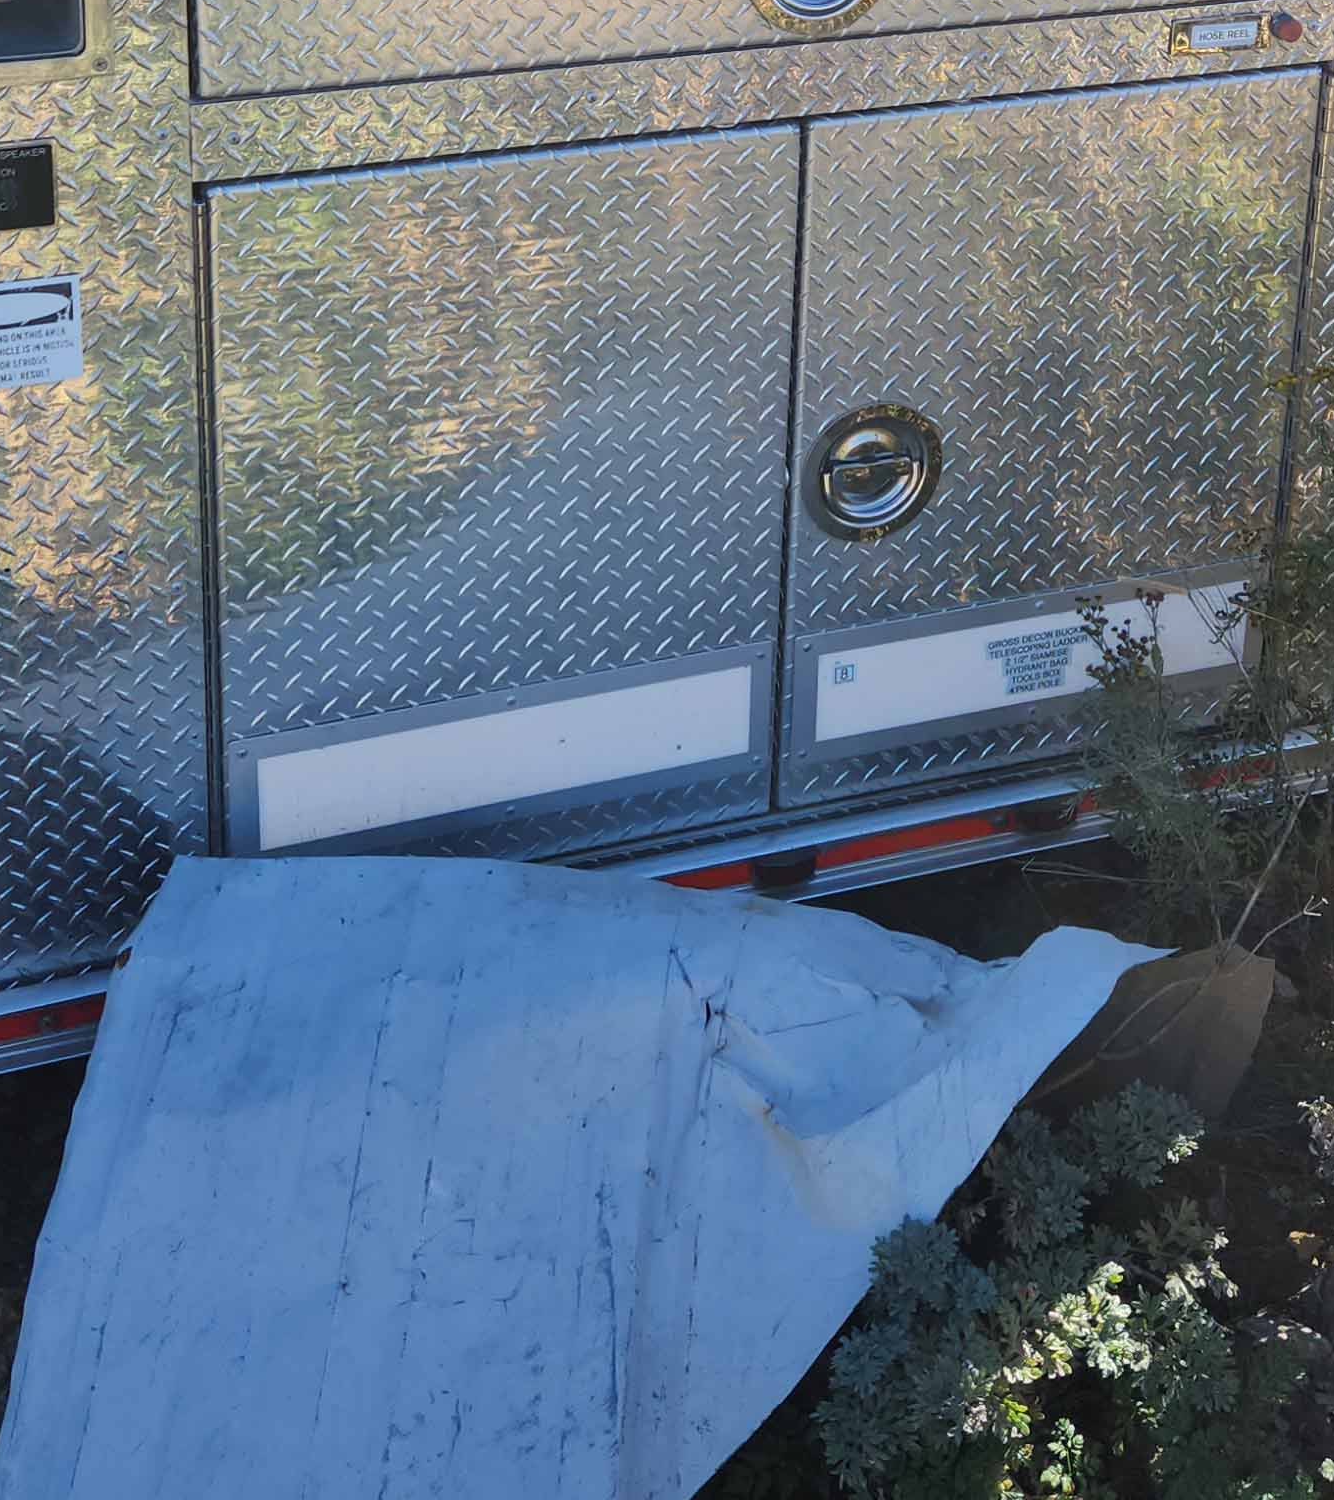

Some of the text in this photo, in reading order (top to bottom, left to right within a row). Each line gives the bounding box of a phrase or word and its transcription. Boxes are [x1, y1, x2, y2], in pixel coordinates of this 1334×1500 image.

[1199, 29, 1251, 41] HOSE REEL
[0, 148, 46, 159] SPEAKER
[11, 332, 22, 342] ON
[25, 330, 43, 339] THIS
[0, 360, 11, 371] OR
[988, 637, 1020, 650] GROSS
[1022, 630, 1053, 644] DECON
[989, 634, 1088, 659] TELESCOPING LADDER
[1030, 647, 1068, 661] SIAMESE
[1006, 658, 1068, 676] HYDRANT BAG
[1012, 671, 1041, 684] TOOLS
[1037, 678, 1060, 689] POLE
